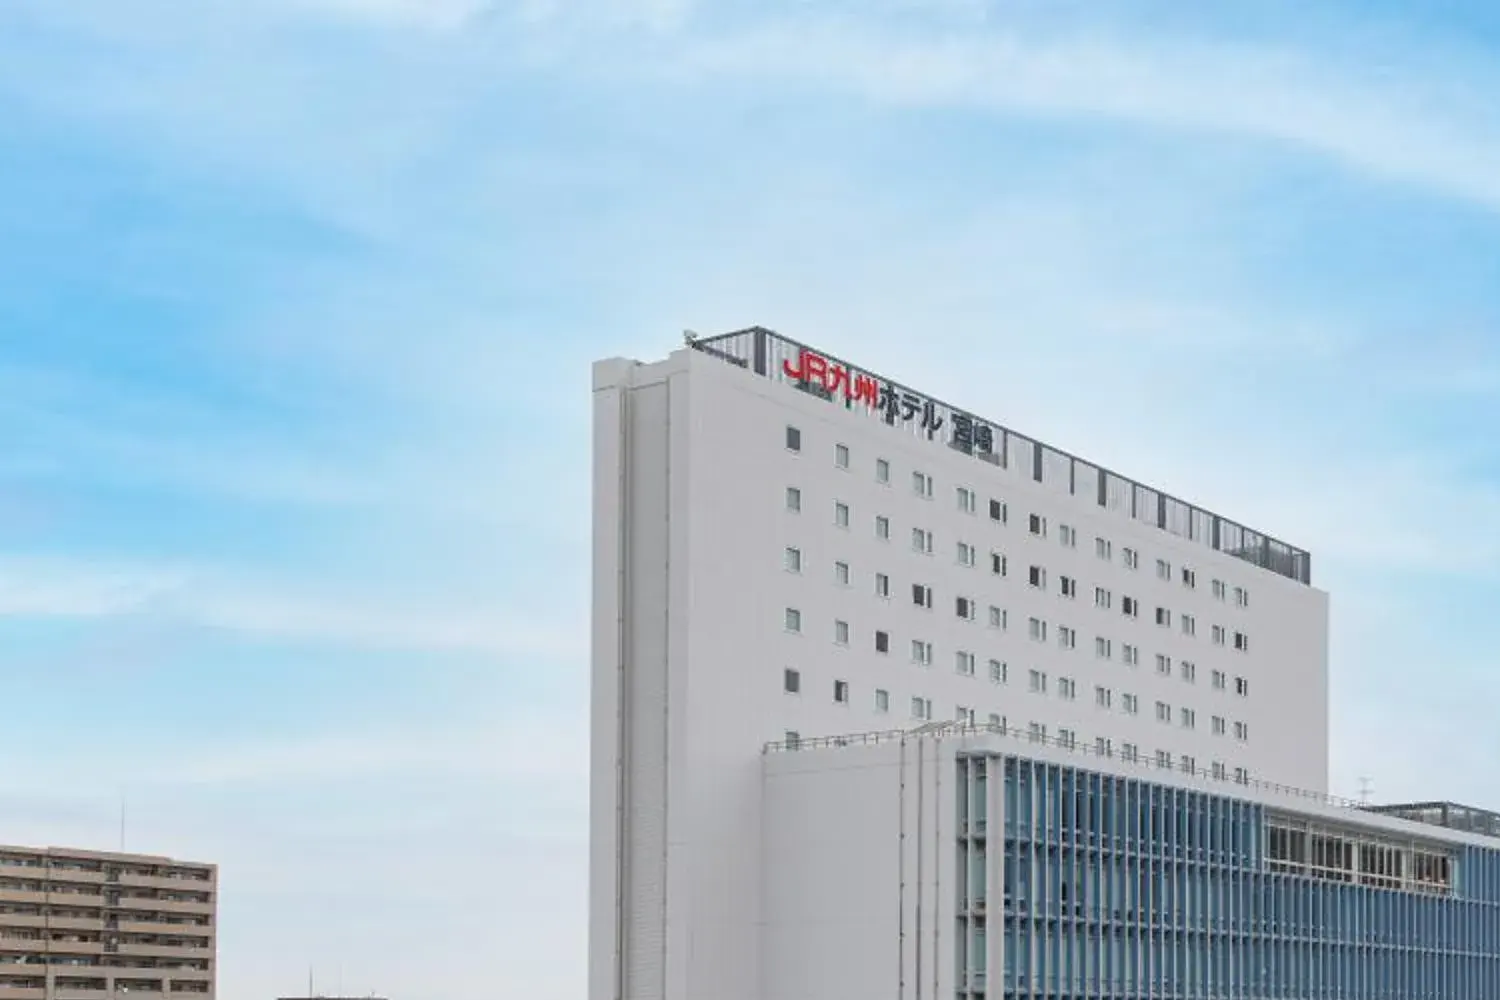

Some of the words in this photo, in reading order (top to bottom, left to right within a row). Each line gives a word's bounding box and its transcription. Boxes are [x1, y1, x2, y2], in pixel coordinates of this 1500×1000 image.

[783, 349, 943, 431] JR九州ホテル
